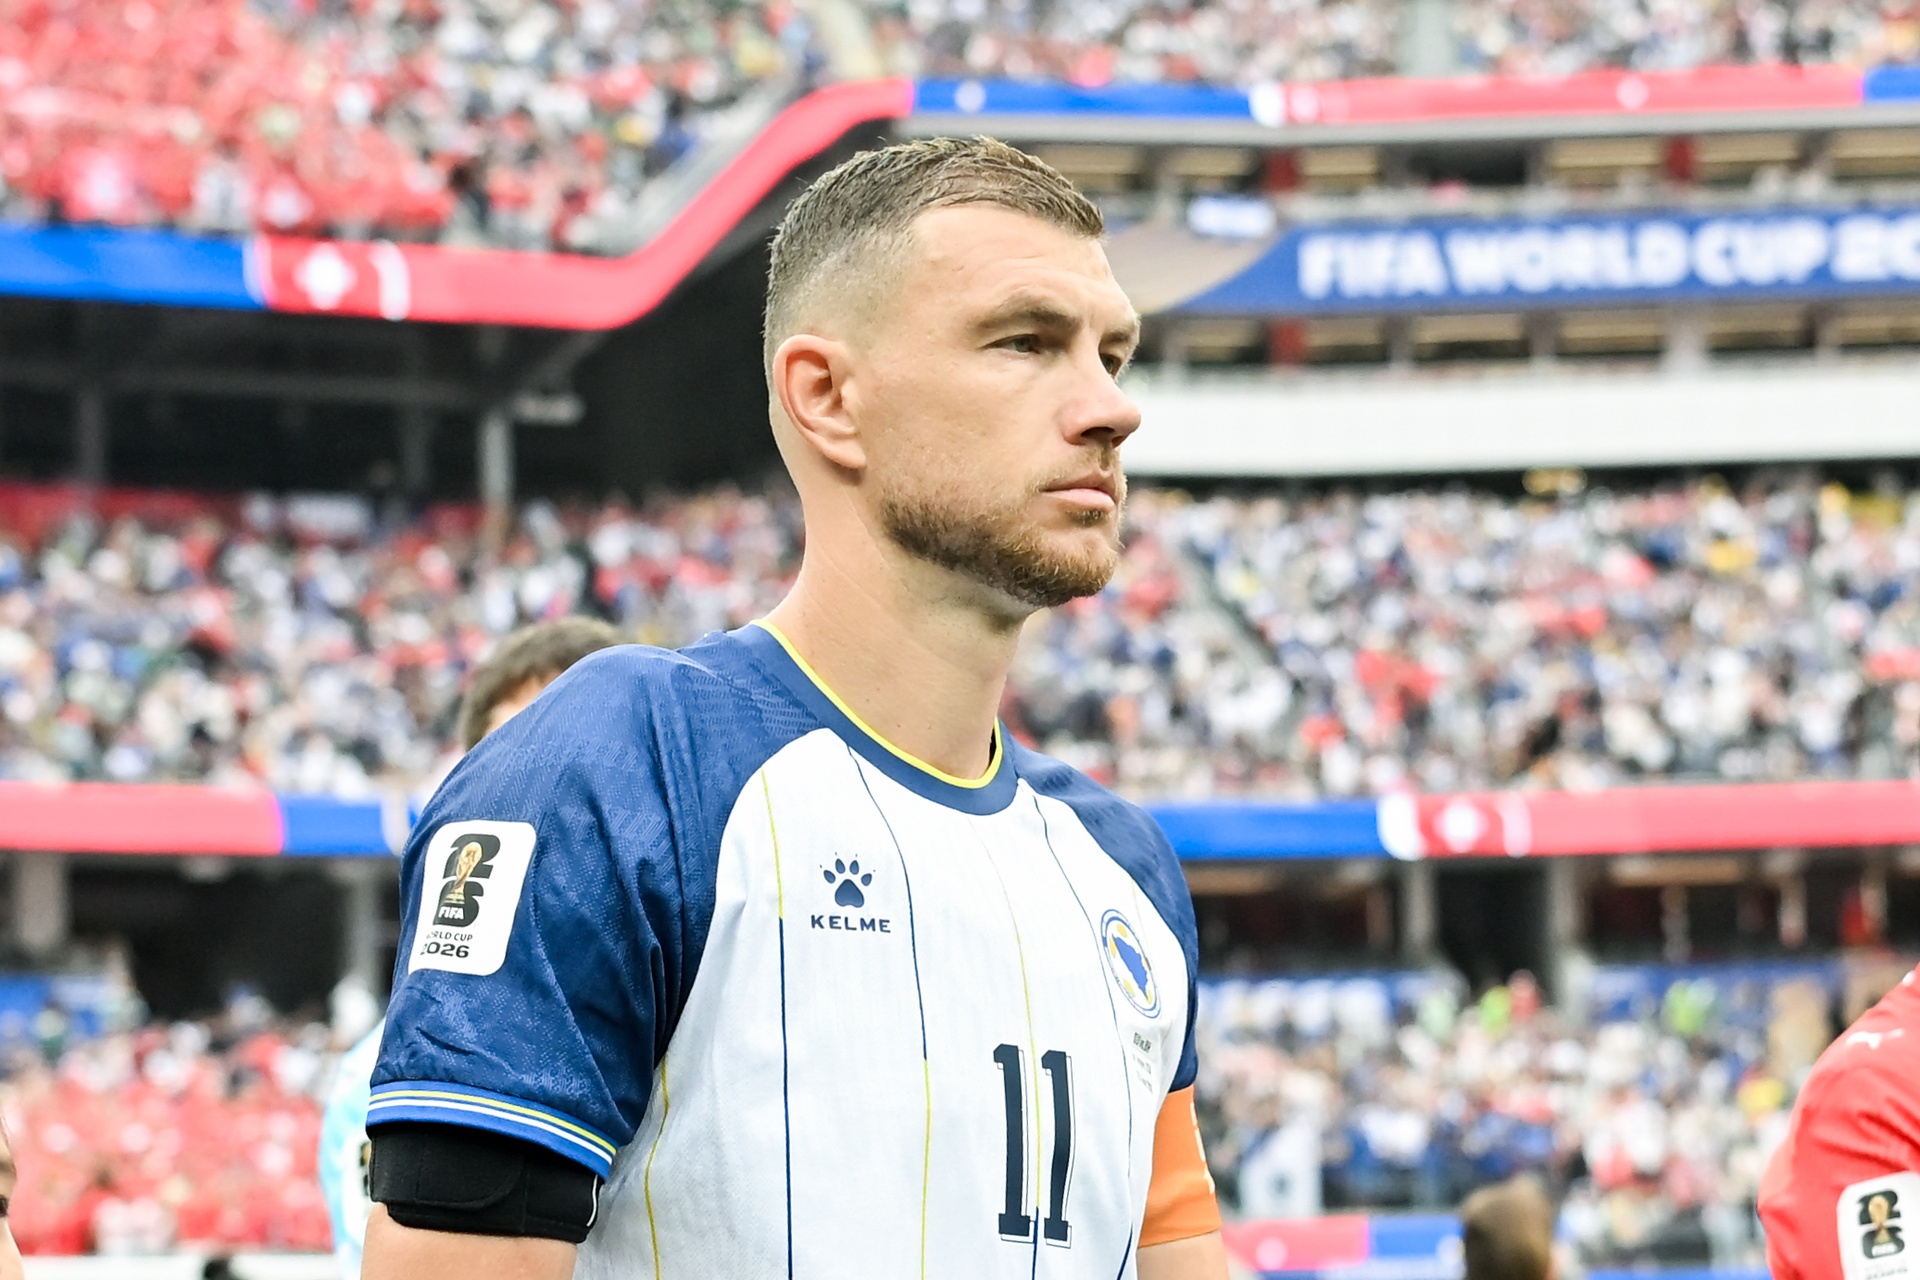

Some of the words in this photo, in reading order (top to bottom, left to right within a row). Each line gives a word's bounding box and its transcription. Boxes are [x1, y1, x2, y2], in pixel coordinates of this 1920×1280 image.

[1300, 231, 1449, 298] FIFA
[1446, 217, 1690, 294] WORLD
[1692, 217, 1829, 286] CUP
[438, 906, 465, 920] FIFA
[811, 914, 891, 933] KELME
[453, 932, 473, 942] CUP
[993, 1043, 1076, 1249] 11
